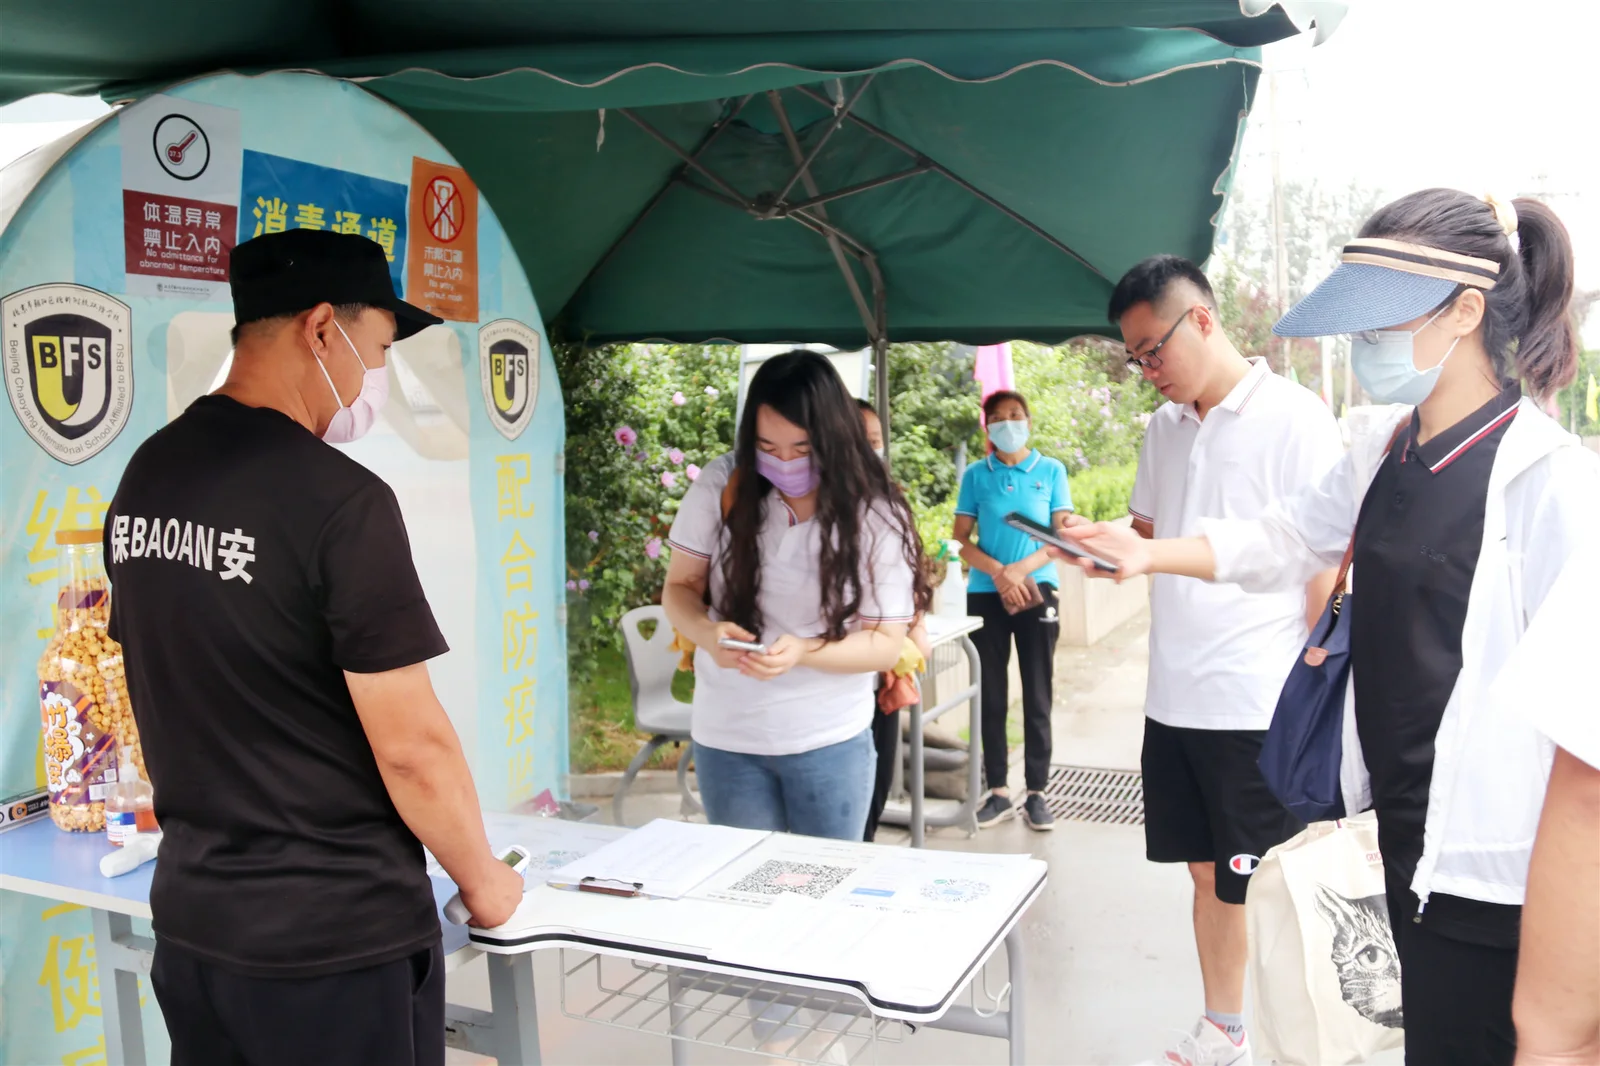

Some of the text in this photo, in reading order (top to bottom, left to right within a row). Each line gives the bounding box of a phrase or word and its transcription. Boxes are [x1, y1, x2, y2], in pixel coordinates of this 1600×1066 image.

[143, 201, 221, 230] 体温异常
[143, 228, 220, 255] 禁止入内
[139, 259, 225, 275] abnormal temperature
[146, 248, 218, 263] No admittance for
[9, 339, 126, 454] Beijing Chaoyang International School Affiliated to BFSU
